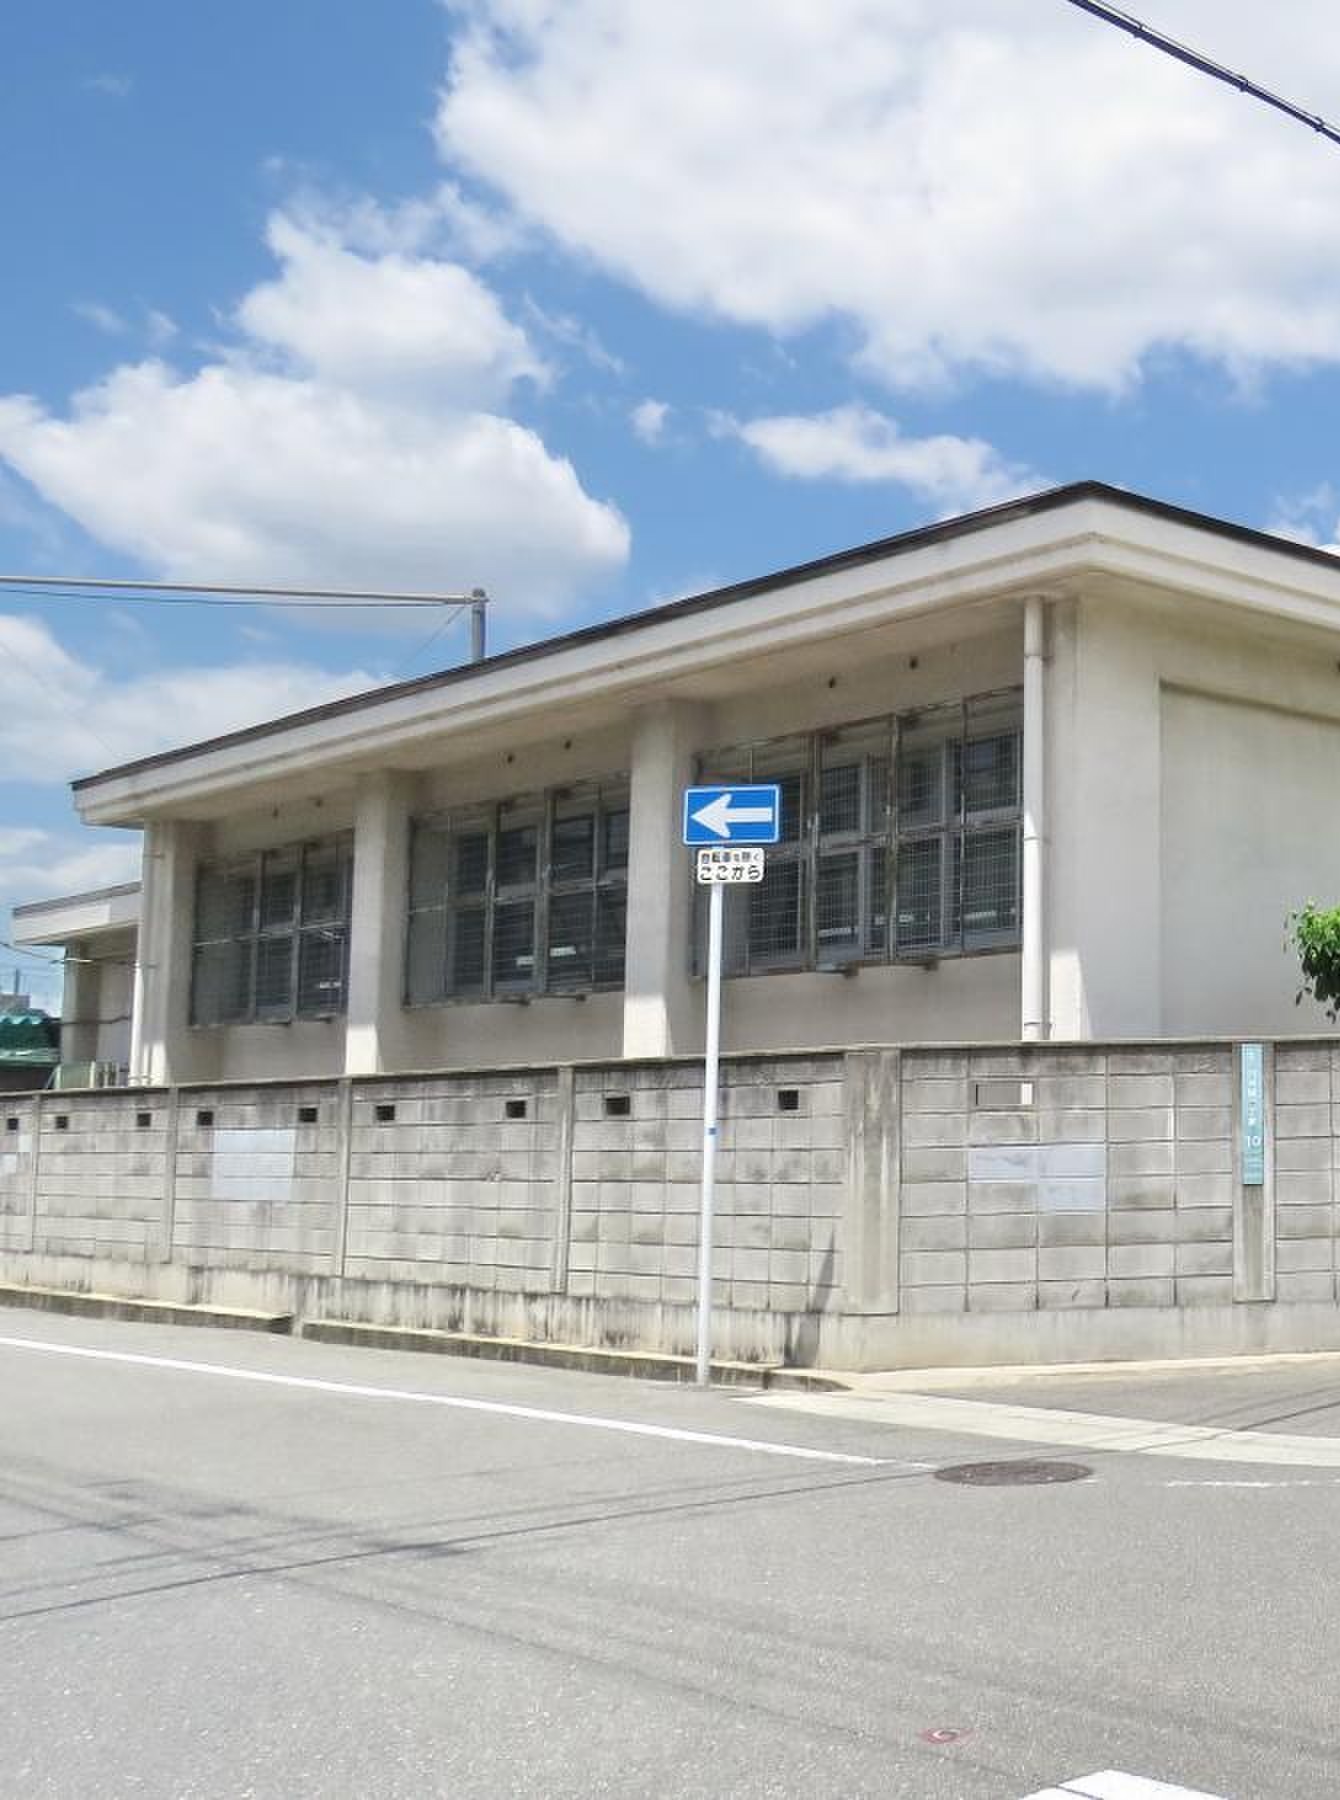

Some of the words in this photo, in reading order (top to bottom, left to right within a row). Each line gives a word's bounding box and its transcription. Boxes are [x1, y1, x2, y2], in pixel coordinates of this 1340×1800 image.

[700, 865, 761, 881] ここから
[1247, 1135, 1262, 1148] 10
